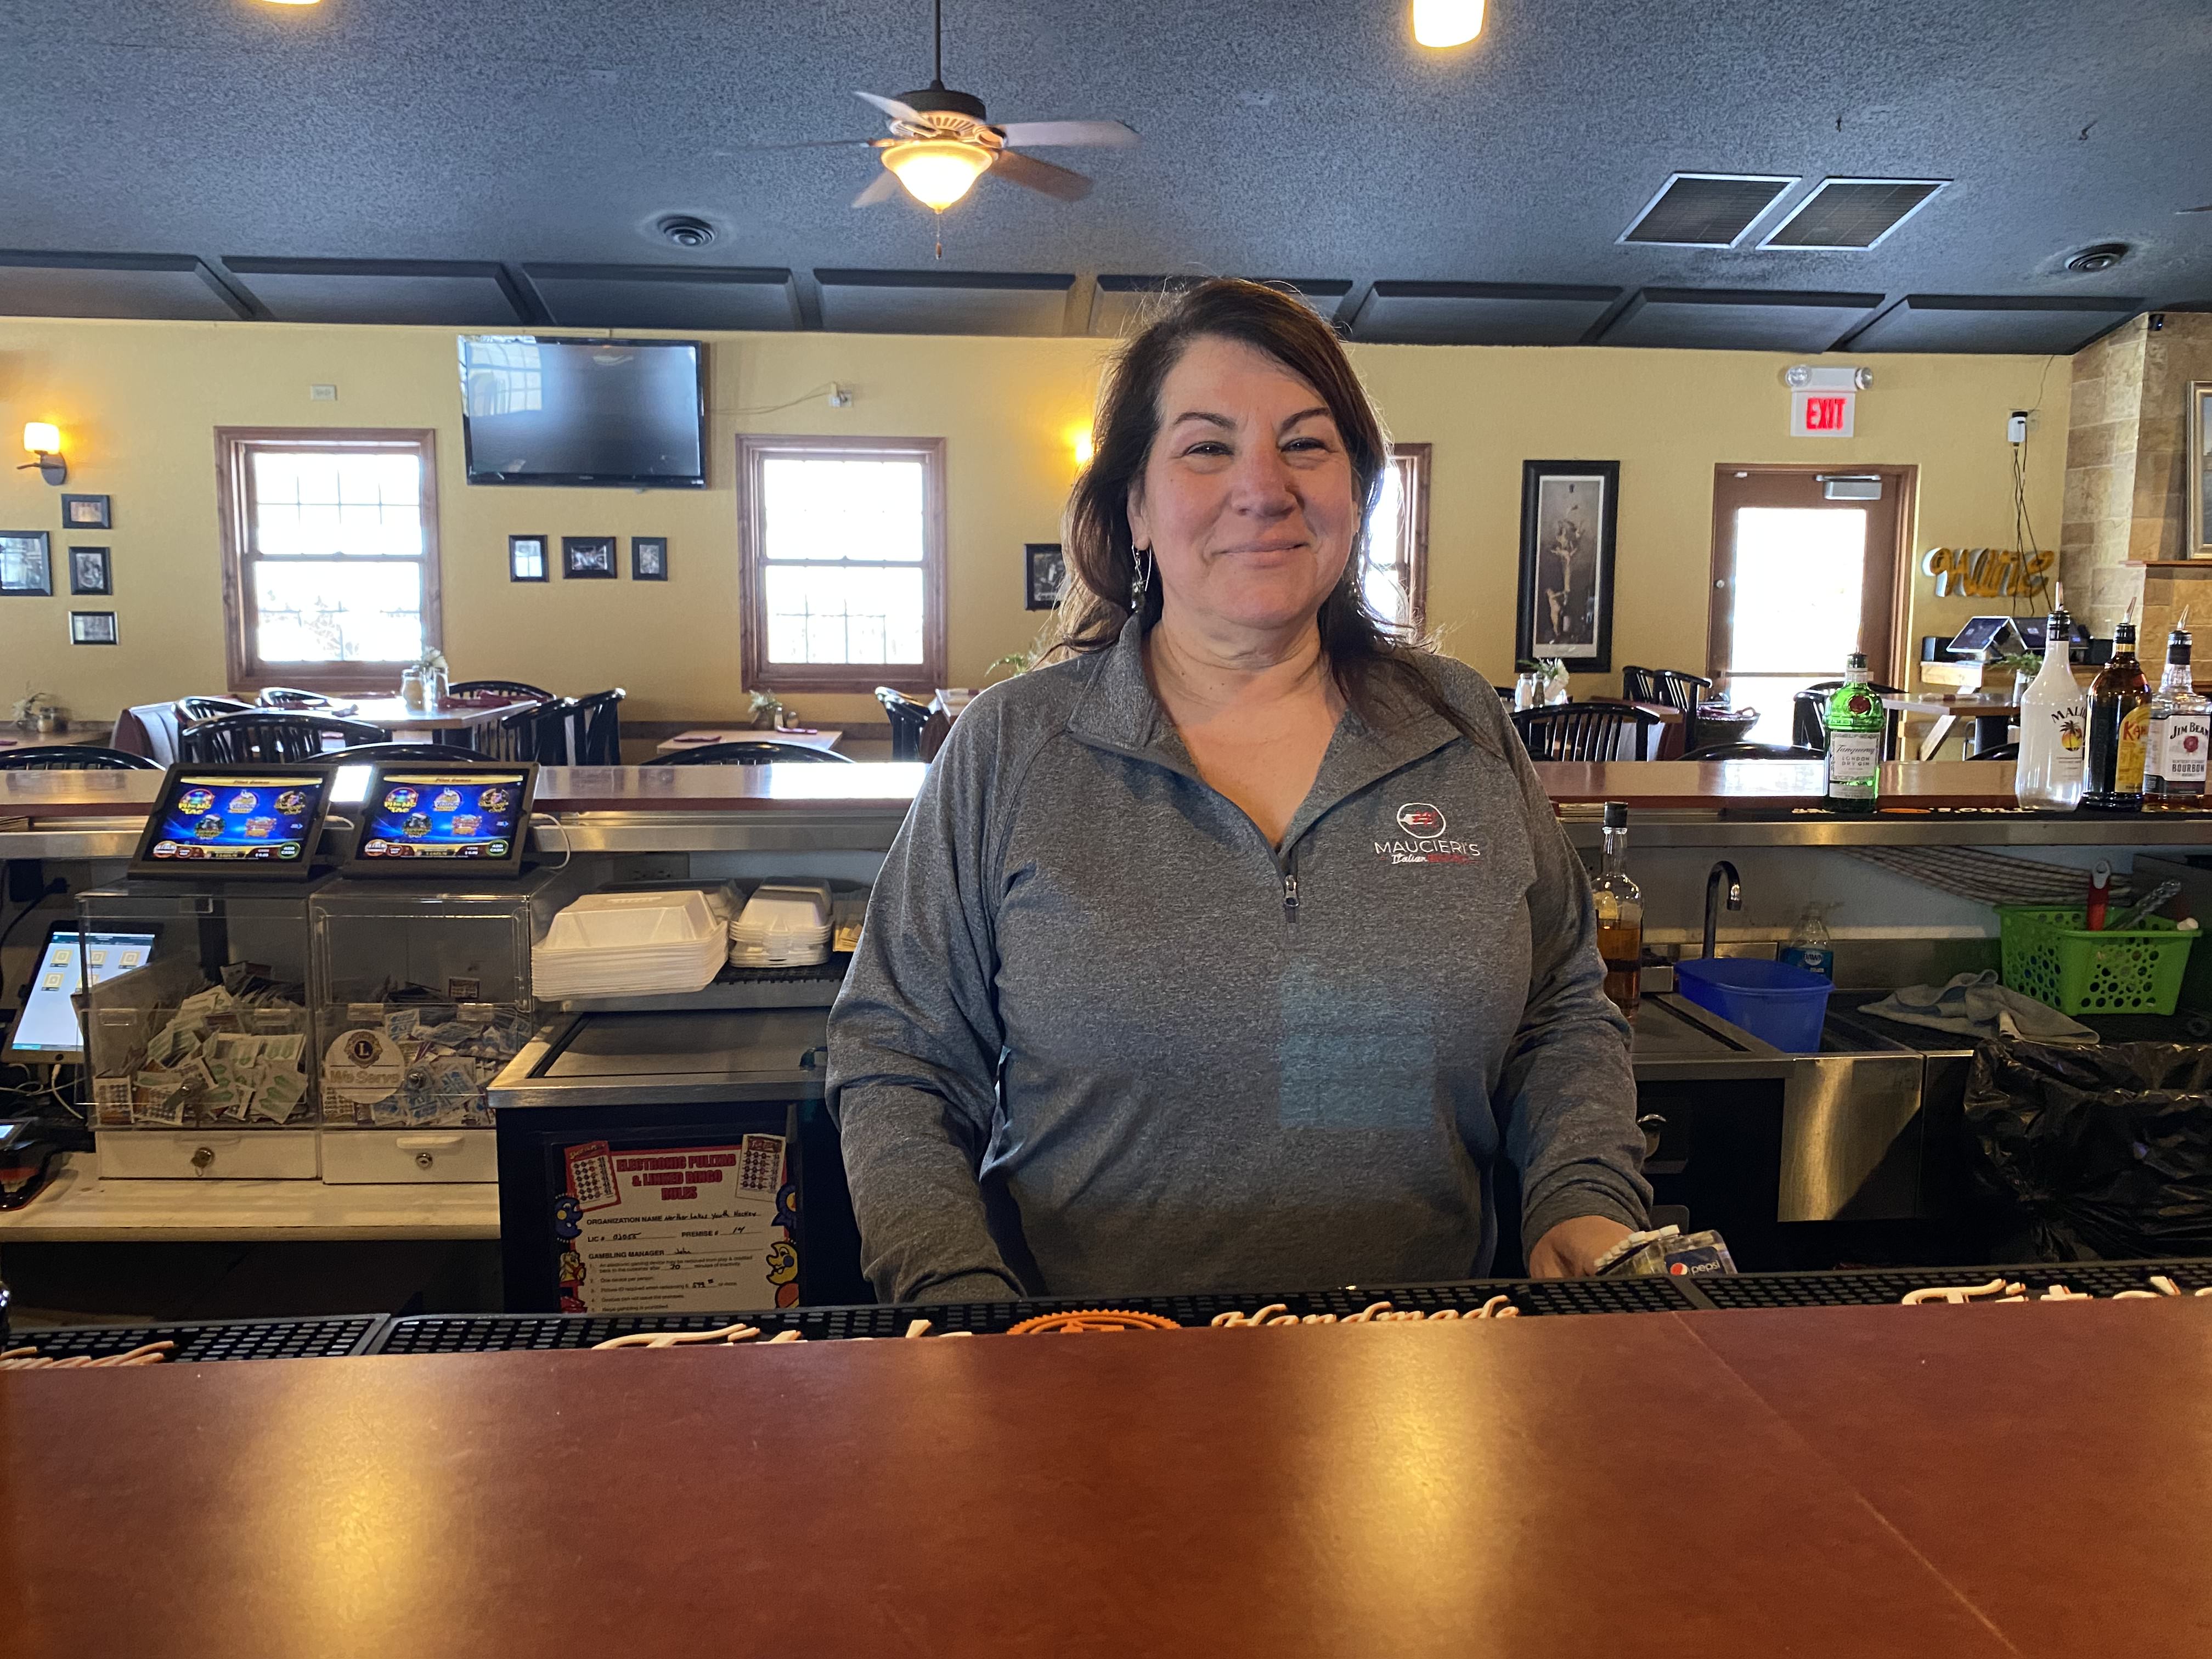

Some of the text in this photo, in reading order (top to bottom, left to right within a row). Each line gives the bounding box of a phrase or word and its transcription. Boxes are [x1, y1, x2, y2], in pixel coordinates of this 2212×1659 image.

[1806, 397, 1847, 430] EXIT
[2170, 725, 2188, 739] JIM
[1836, 744, 1875, 754] Tanqueray
[1374, 840, 1481, 856] MAUCIERI'S
[1391, 853, 1428, 864] Italian
[359, 1043, 369, 1056] L
[330, 1070, 400, 1084] We Serve
[617, 1156, 686, 1171] ELECTRONIC
[633, 1170, 722, 1186] & LINKED BINGO
[662, 1187, 697, 1200] RULES
[1690, 1260, 1720, 1275] pepsi
